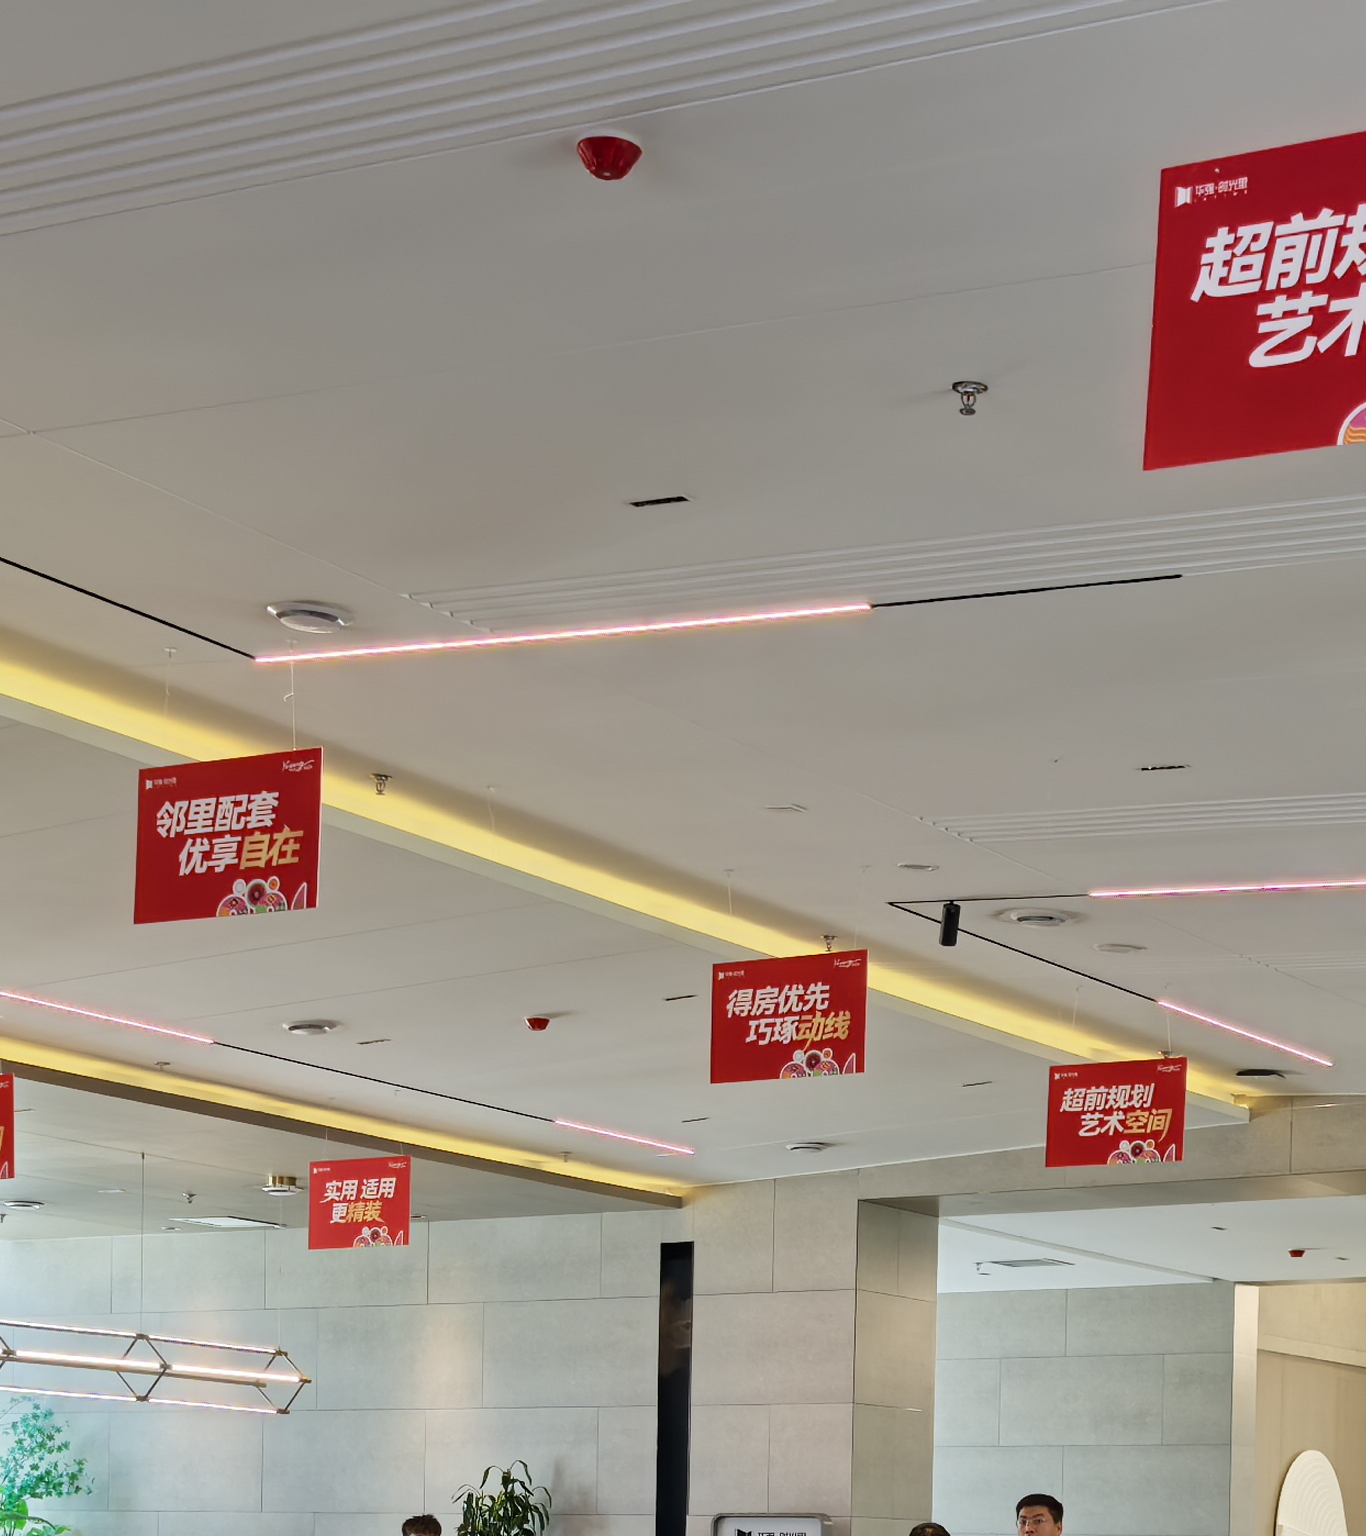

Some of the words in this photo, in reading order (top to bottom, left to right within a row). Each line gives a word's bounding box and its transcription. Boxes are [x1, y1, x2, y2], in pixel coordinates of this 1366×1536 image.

[156, 790, 279, 838] 邻里配套
[178, 824, 304, 876] 优享自在
[726, 981, 830, 1018] 得房优先
[745, 1010, 851, 1053] 巧琢动线
[1059, 1083, 1155, 1112] 超前规划
[1078, 1108, 1173, 1142] 艺术空间
[319, 1180, 359, 1203] 实用
[360, 1177, 396, 1199] 适用
[330, 1200, 385, 1224] 更精装
